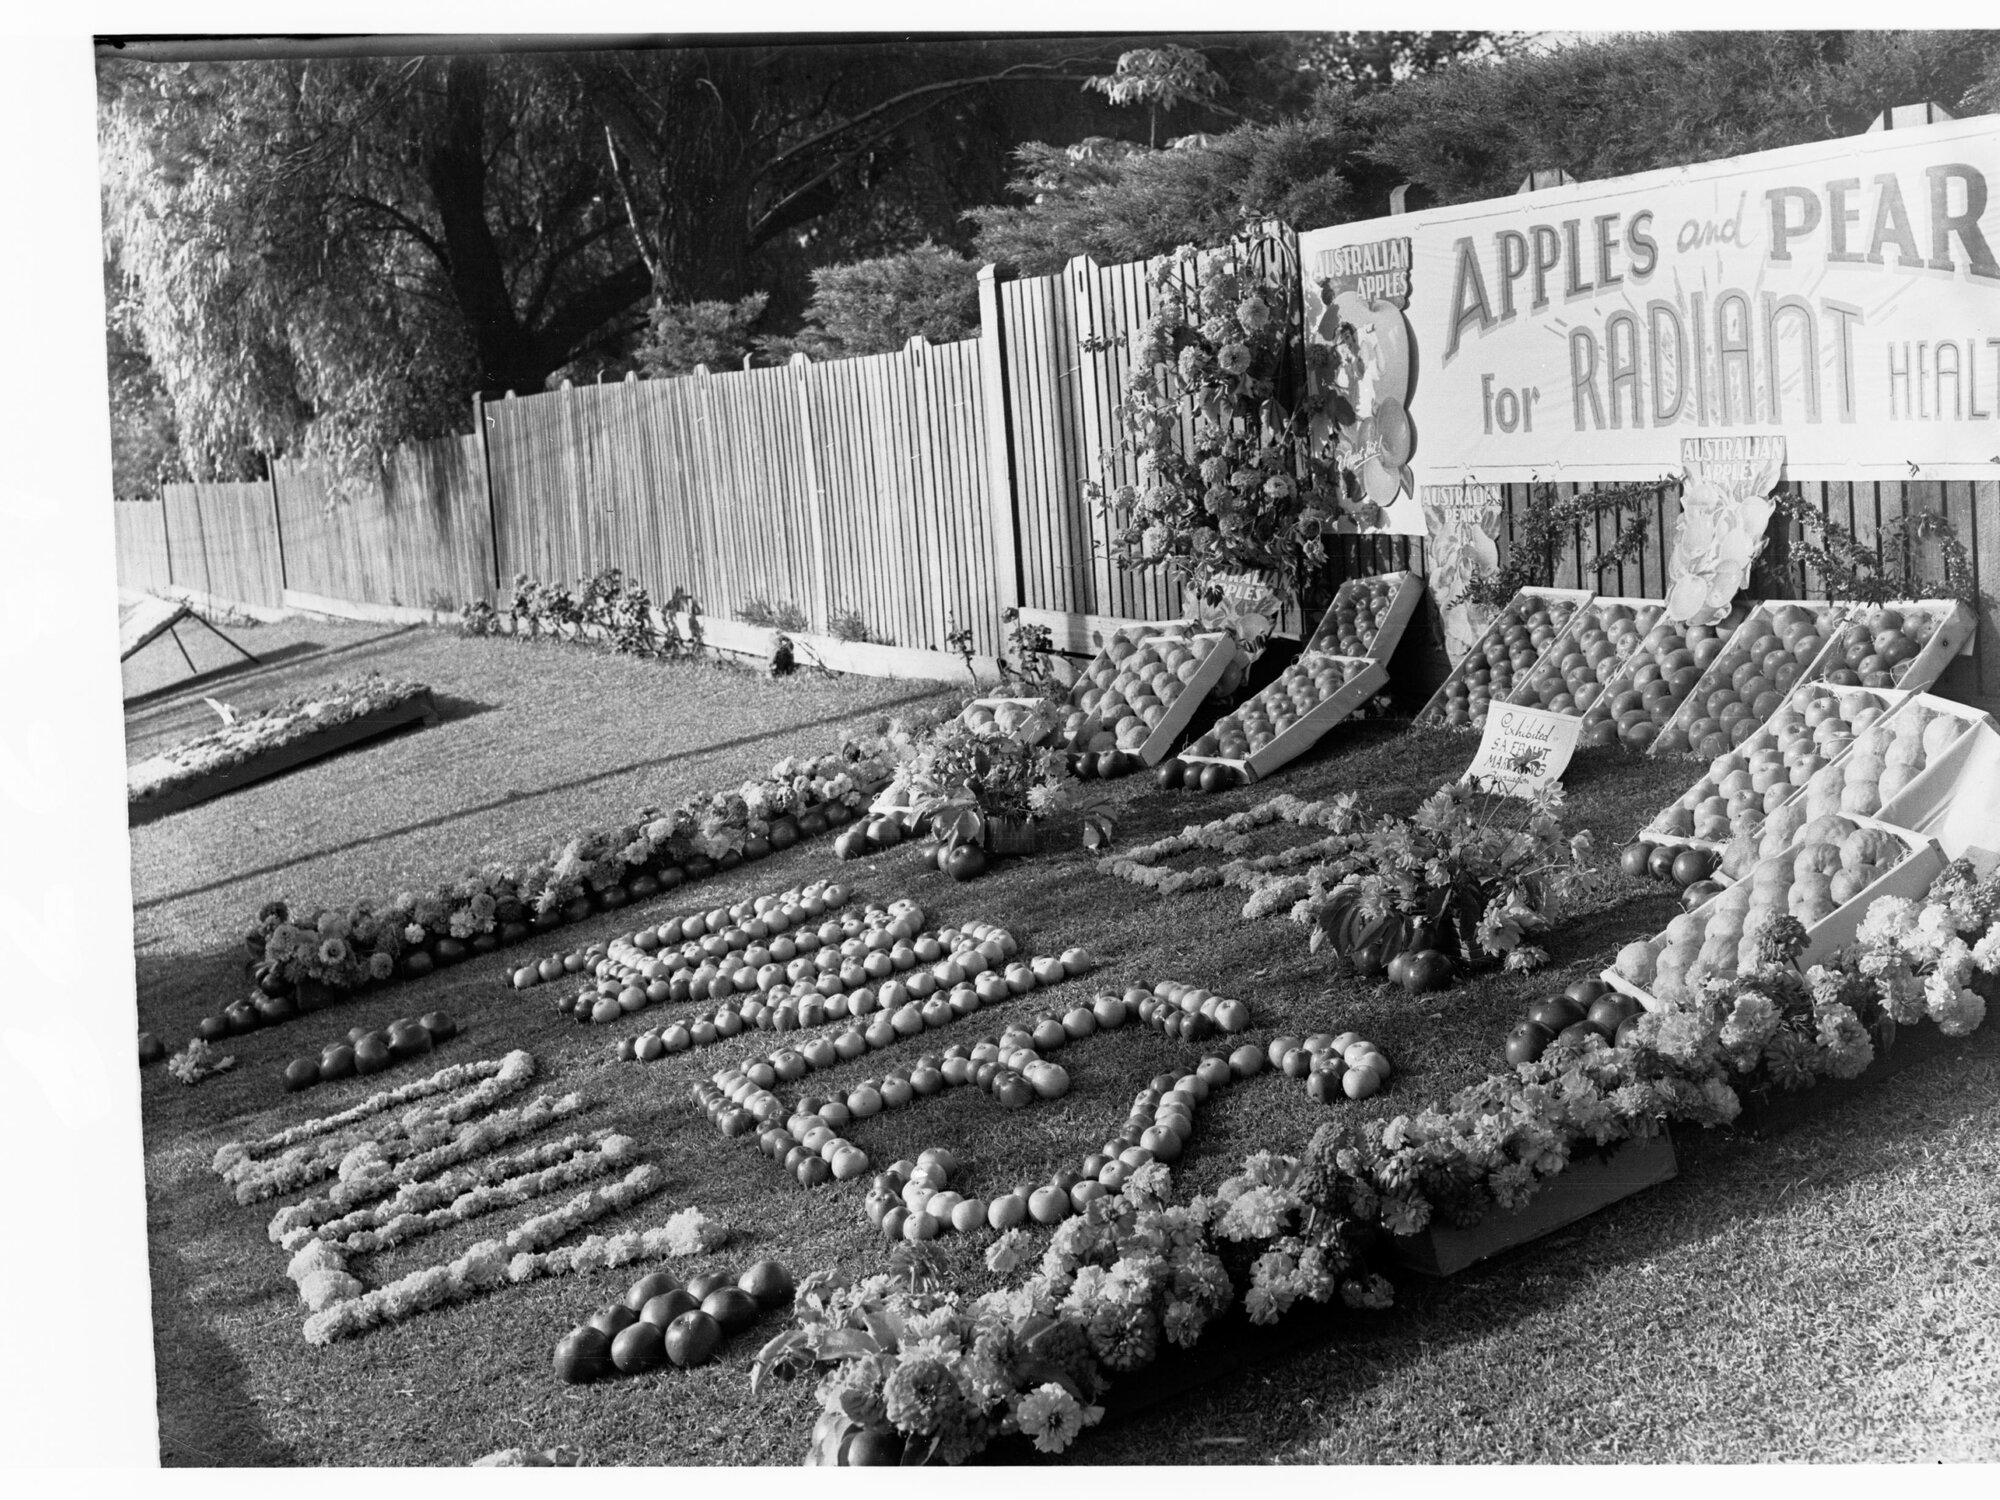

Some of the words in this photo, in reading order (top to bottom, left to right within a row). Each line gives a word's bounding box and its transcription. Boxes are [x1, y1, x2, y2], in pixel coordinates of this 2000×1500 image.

[1315, 237, 1409, 280] AUSTRALIAN
[1357, 270, 1408, 300] APPLES
[1442, 209, 1658, 369] APPLES
[1677, 190, 1758, 254] and
[1481, 373, 1541, 435] For
[1568, 287, 1864, 432] RADIANT
[1682, 436, 1783, 461] AUSTRALIAN
[1704, 462, 1757, 481] APPLES
[1422, 485, 1501, 506] AUSTRALIAN
[1445, 508, 1482, 523] PEARS
[1211, 564, 1291, 590] TRALIAN
[1501, 712, 1556, 742] Exhibited
[1484, 754, 1547, 778] MARNG
